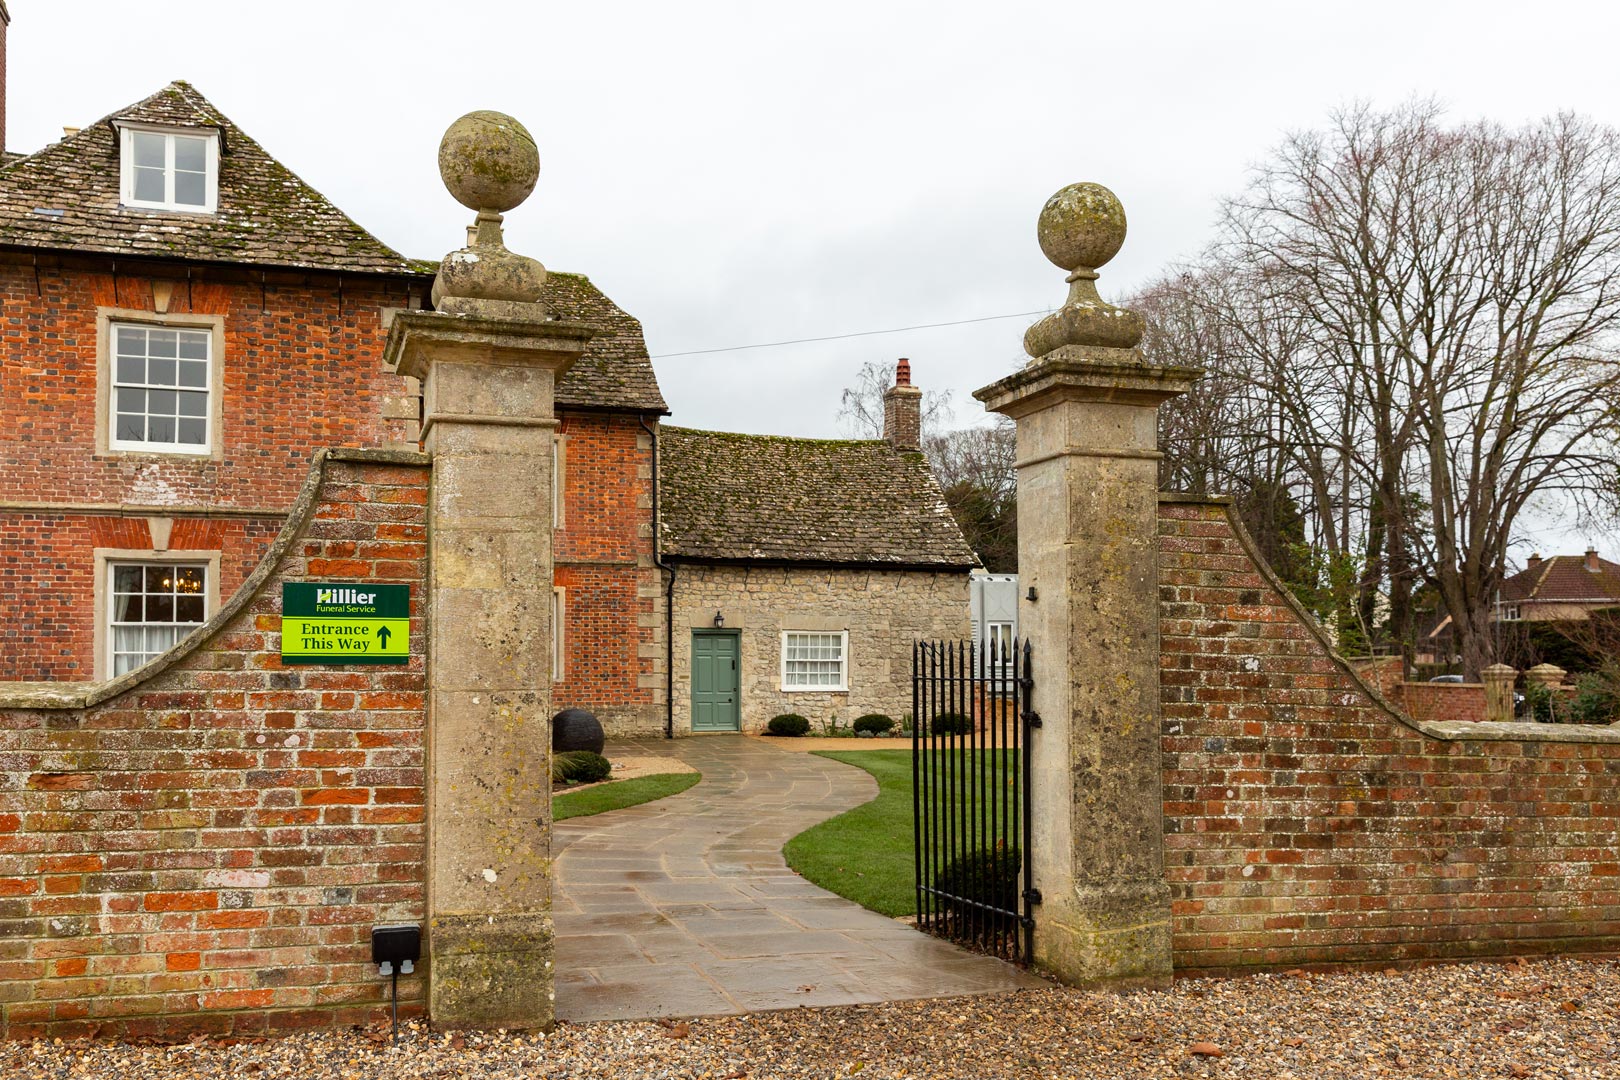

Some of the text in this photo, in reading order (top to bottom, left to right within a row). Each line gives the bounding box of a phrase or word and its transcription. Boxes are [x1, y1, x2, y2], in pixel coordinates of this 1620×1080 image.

[316, 588, 377, 605] Hillier
[316, 605, 377, 613] Funeral Service
[301, 623, 370, 635] Entrance
[301, 637, 371, 653] This Way
